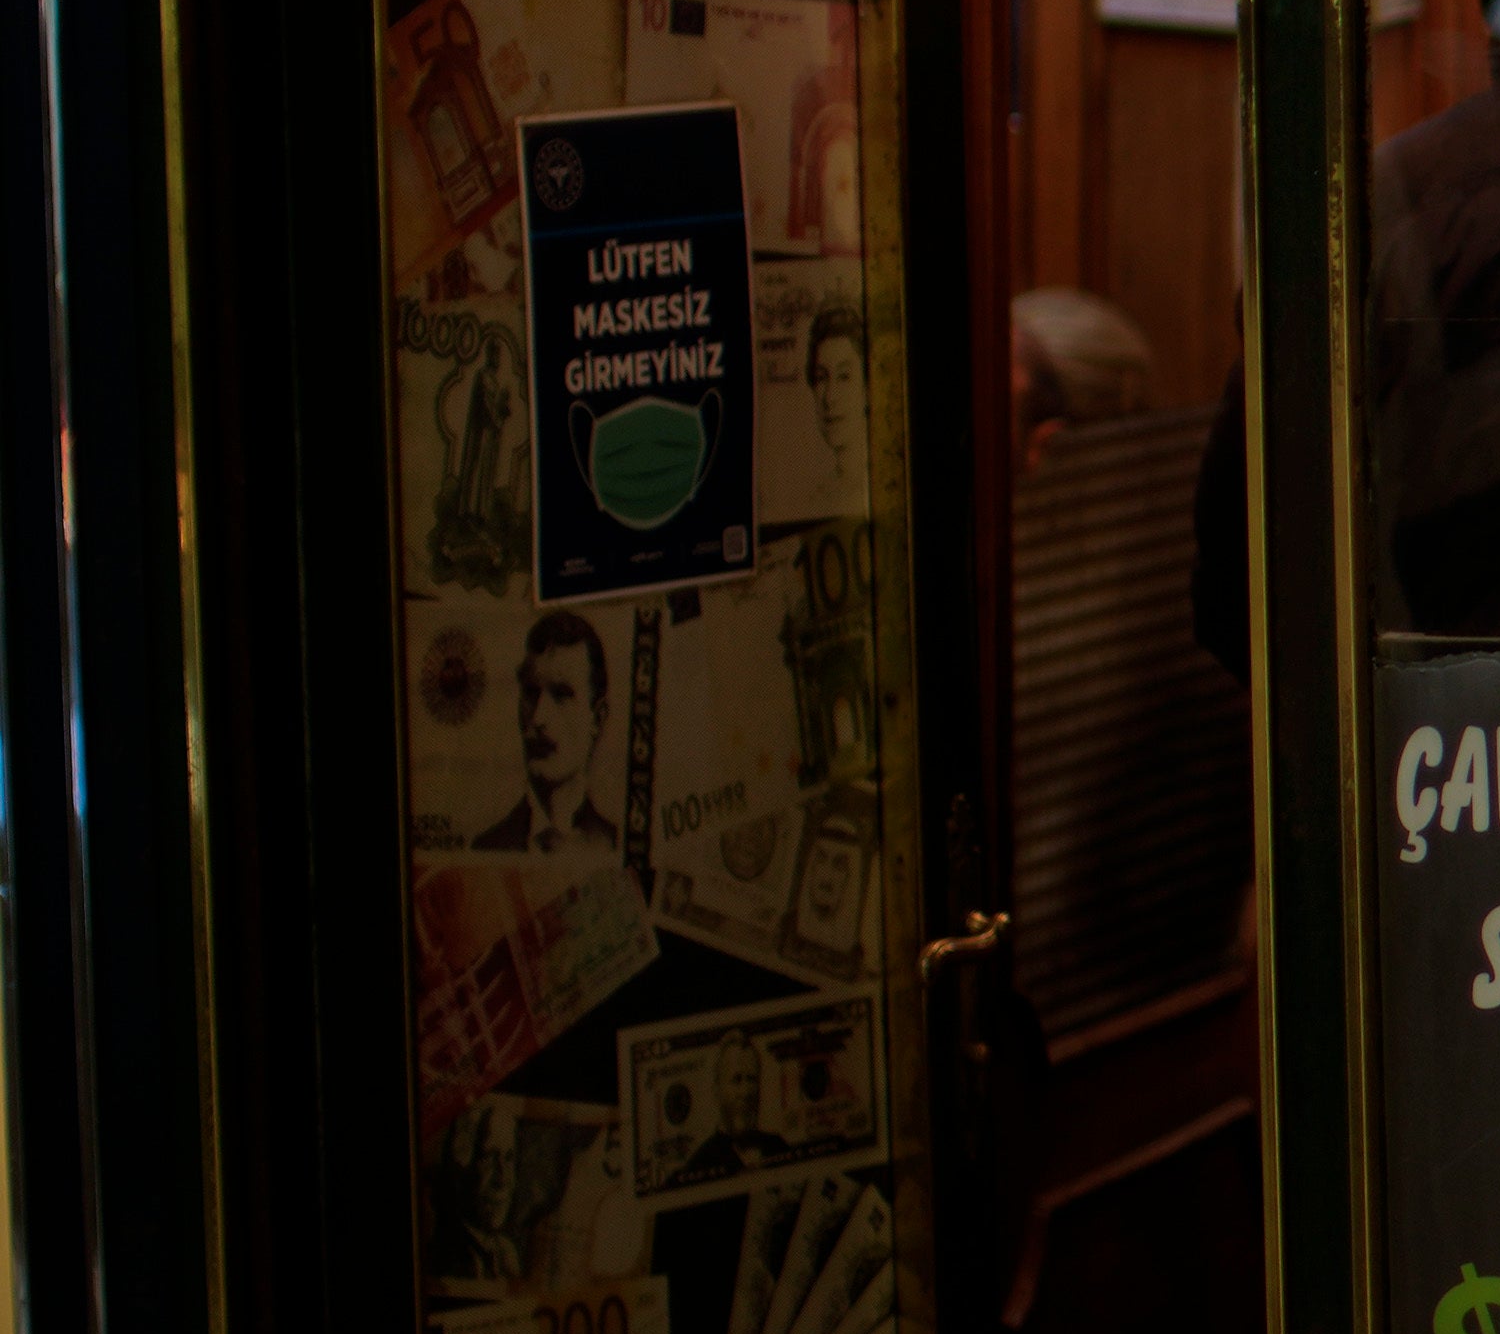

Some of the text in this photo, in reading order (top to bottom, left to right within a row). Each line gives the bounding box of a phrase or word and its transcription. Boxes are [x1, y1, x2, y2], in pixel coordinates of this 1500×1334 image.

[587, 239, 694, 281] LÜTFEN
[572, 288, 711, 339] MASKESİZ
[565, 341, 724, 396] GİRMEYİNİZ
